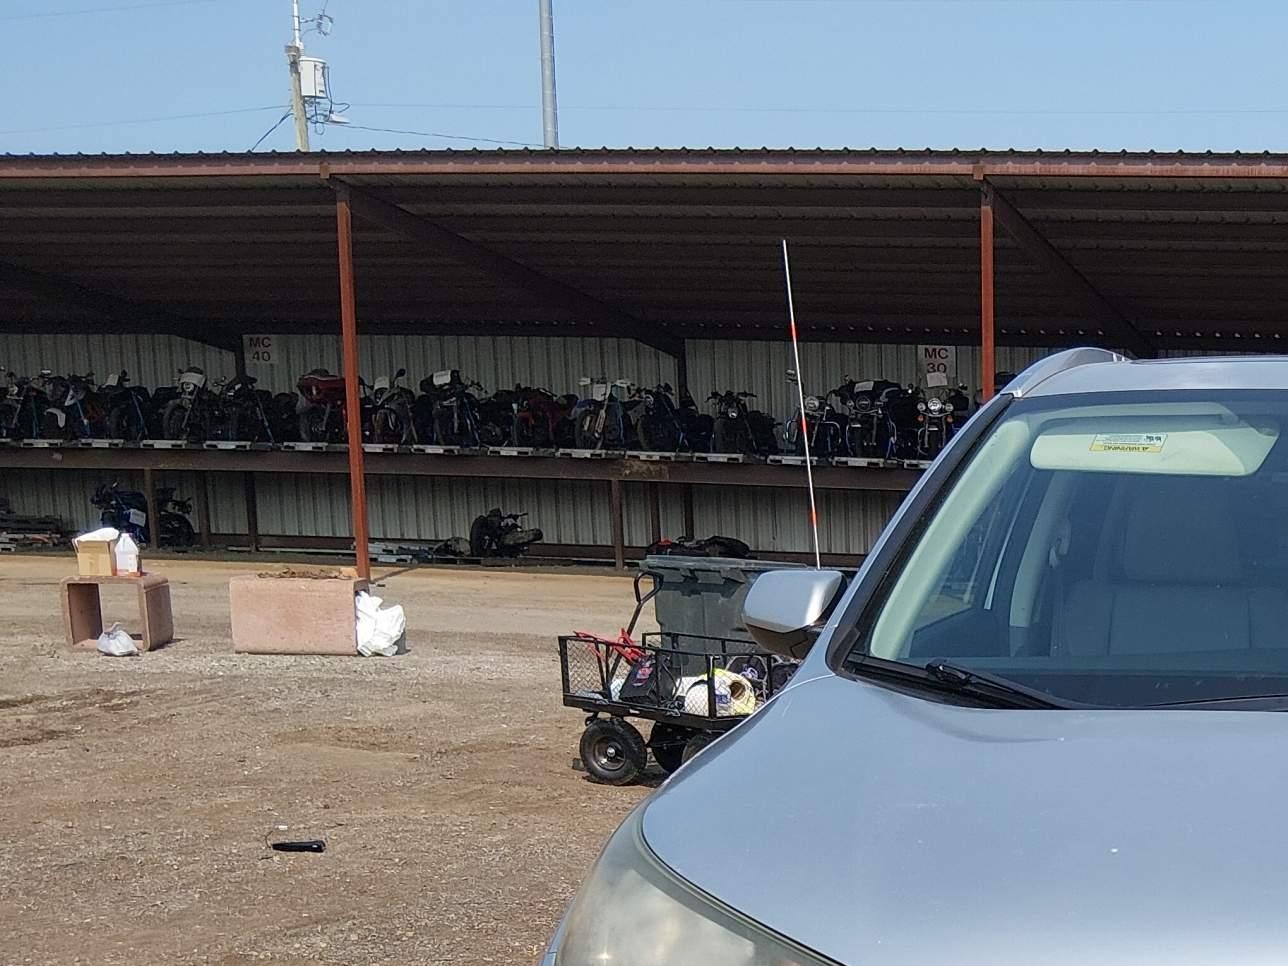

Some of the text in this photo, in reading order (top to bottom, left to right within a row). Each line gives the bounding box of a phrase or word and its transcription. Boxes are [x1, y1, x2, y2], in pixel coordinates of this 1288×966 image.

[249, 336, 272, 348] MC
[252, 351, 271, 362] 40
[924, 347, 949, 360] MC
[927, 362, 947, 374] 30
